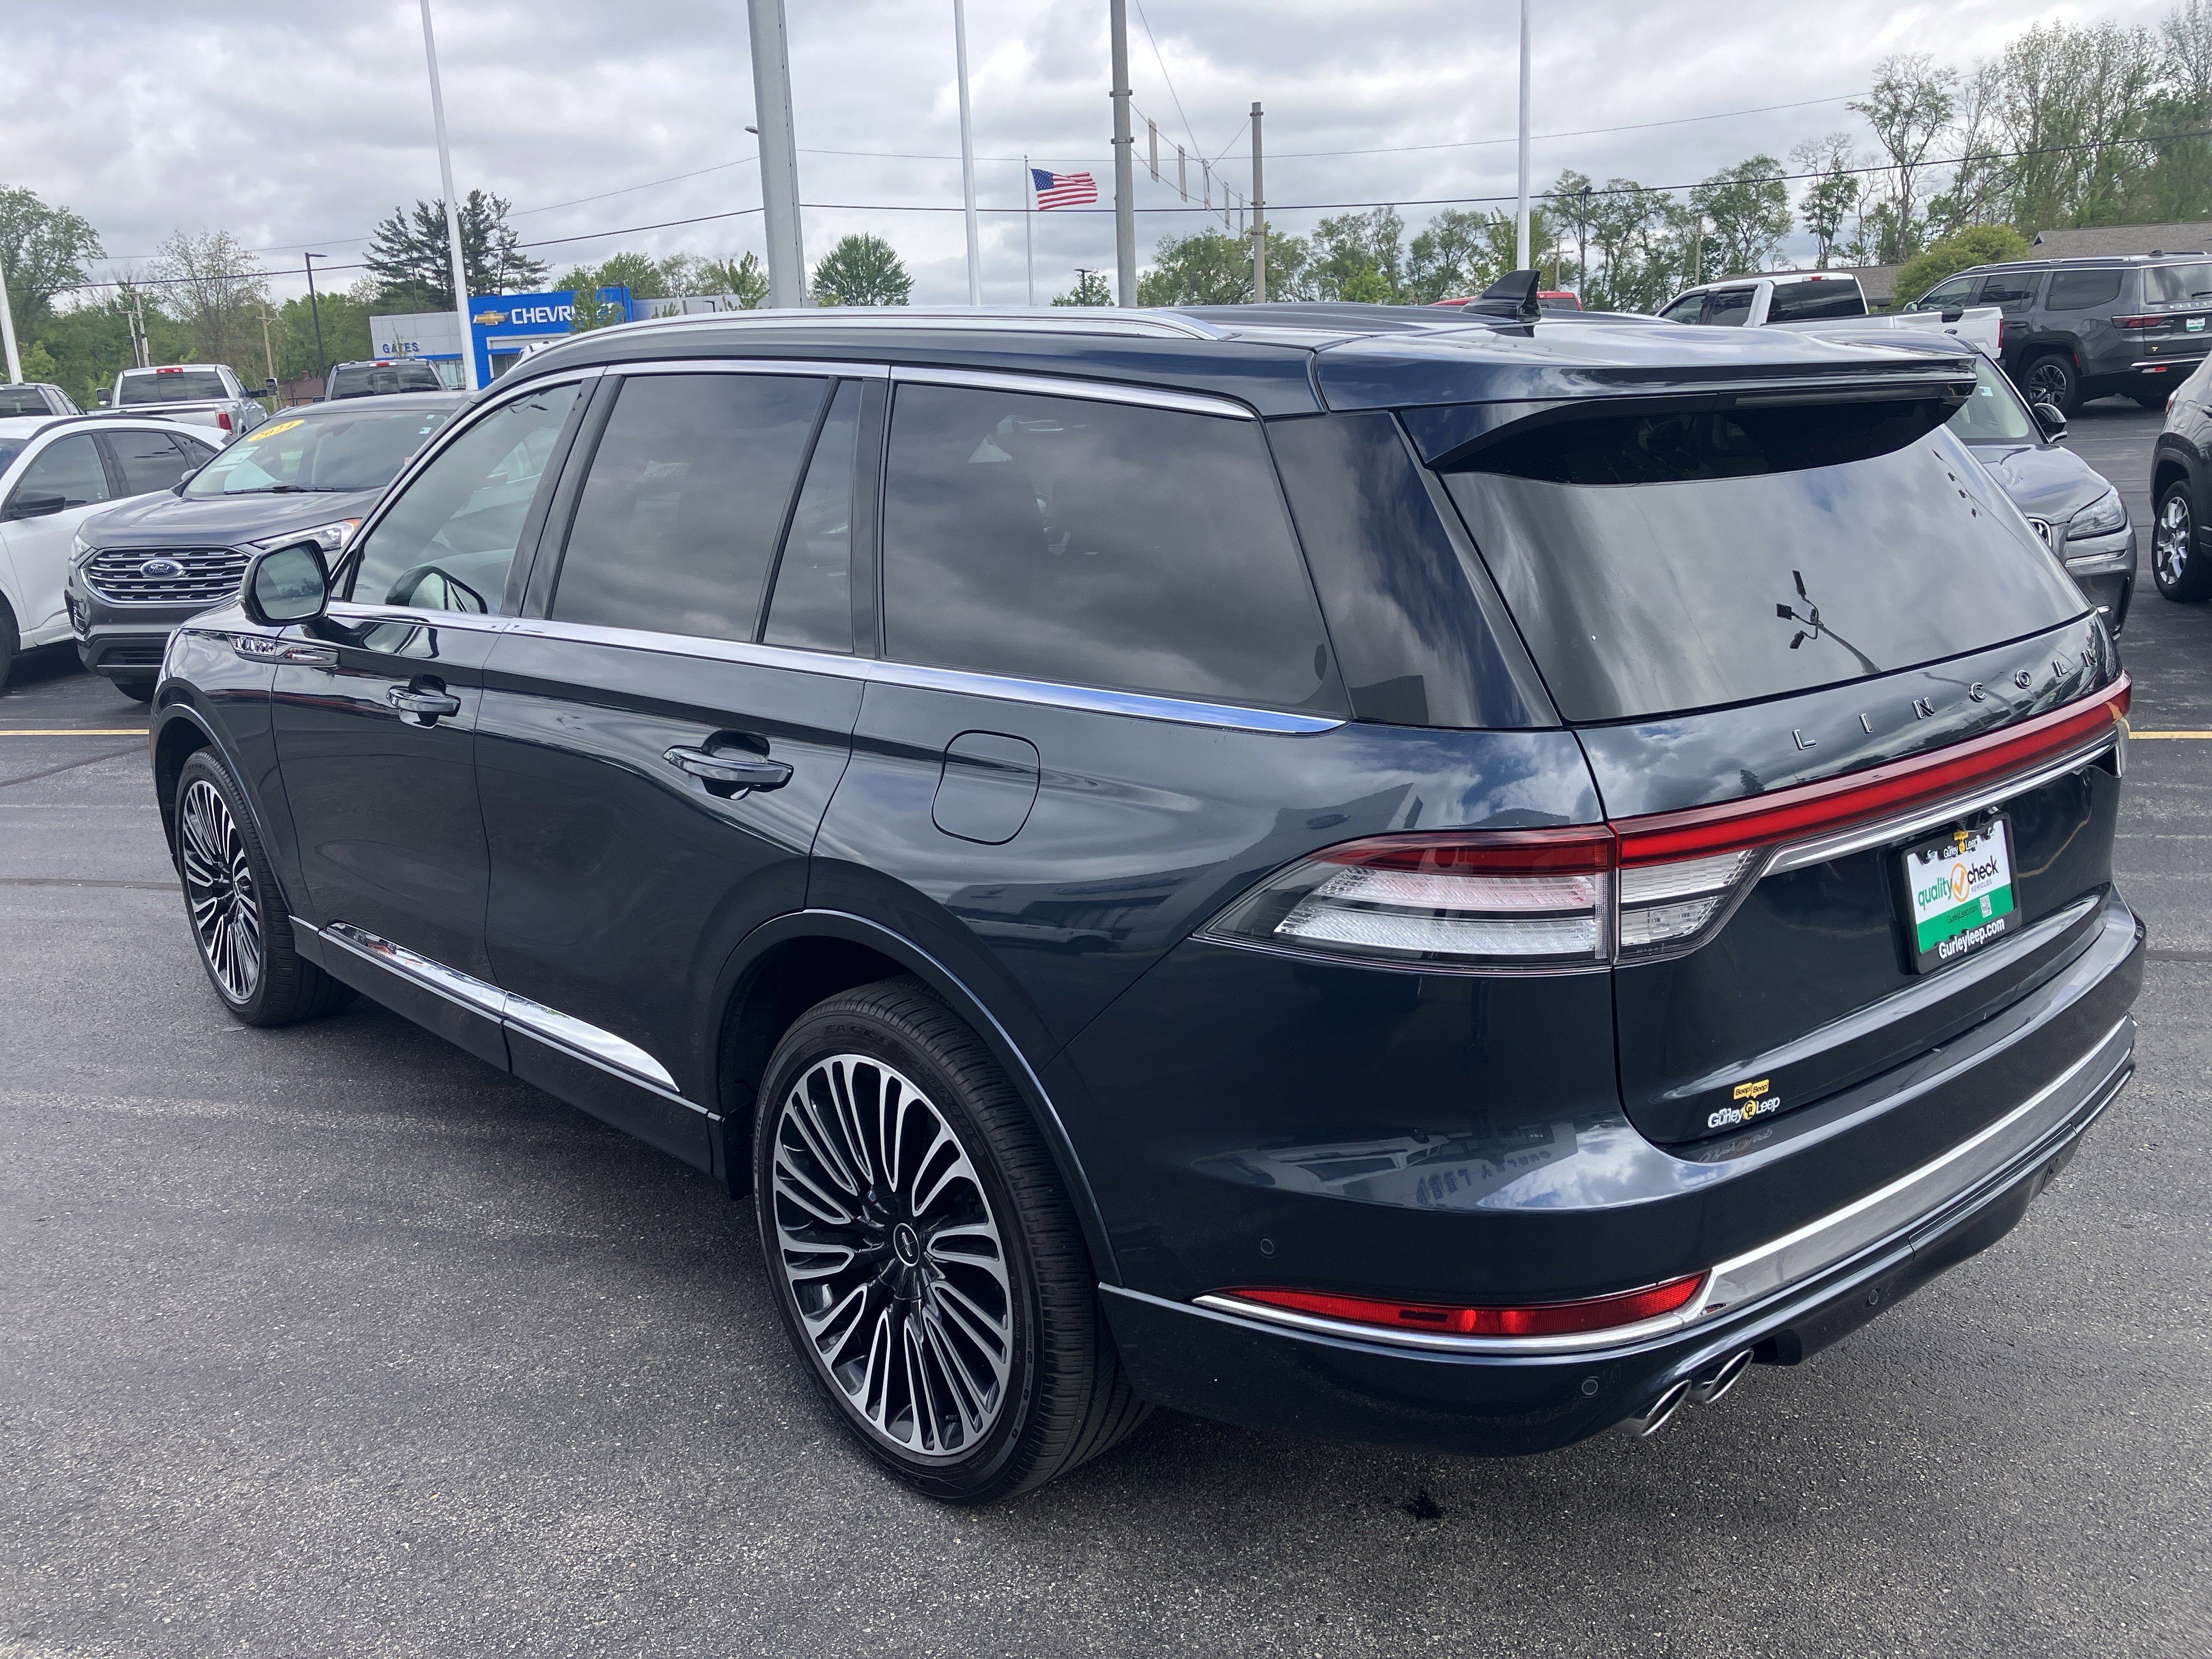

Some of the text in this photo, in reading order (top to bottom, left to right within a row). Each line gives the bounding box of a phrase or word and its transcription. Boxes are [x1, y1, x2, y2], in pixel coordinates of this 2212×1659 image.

[149, 563, 170, 574] Ford
[1792, 648, 2097, 751] LINCOLN
[1918, 855, 1999, 910] quality check
[1971, 879, 1993, 893] VEHICLES
[1938, 918, 2005, 959] Gurleyleep.com
[1707, 1107, 1744, 1128] Gurley
[1756, 1097, 1781, 1115] Leep
